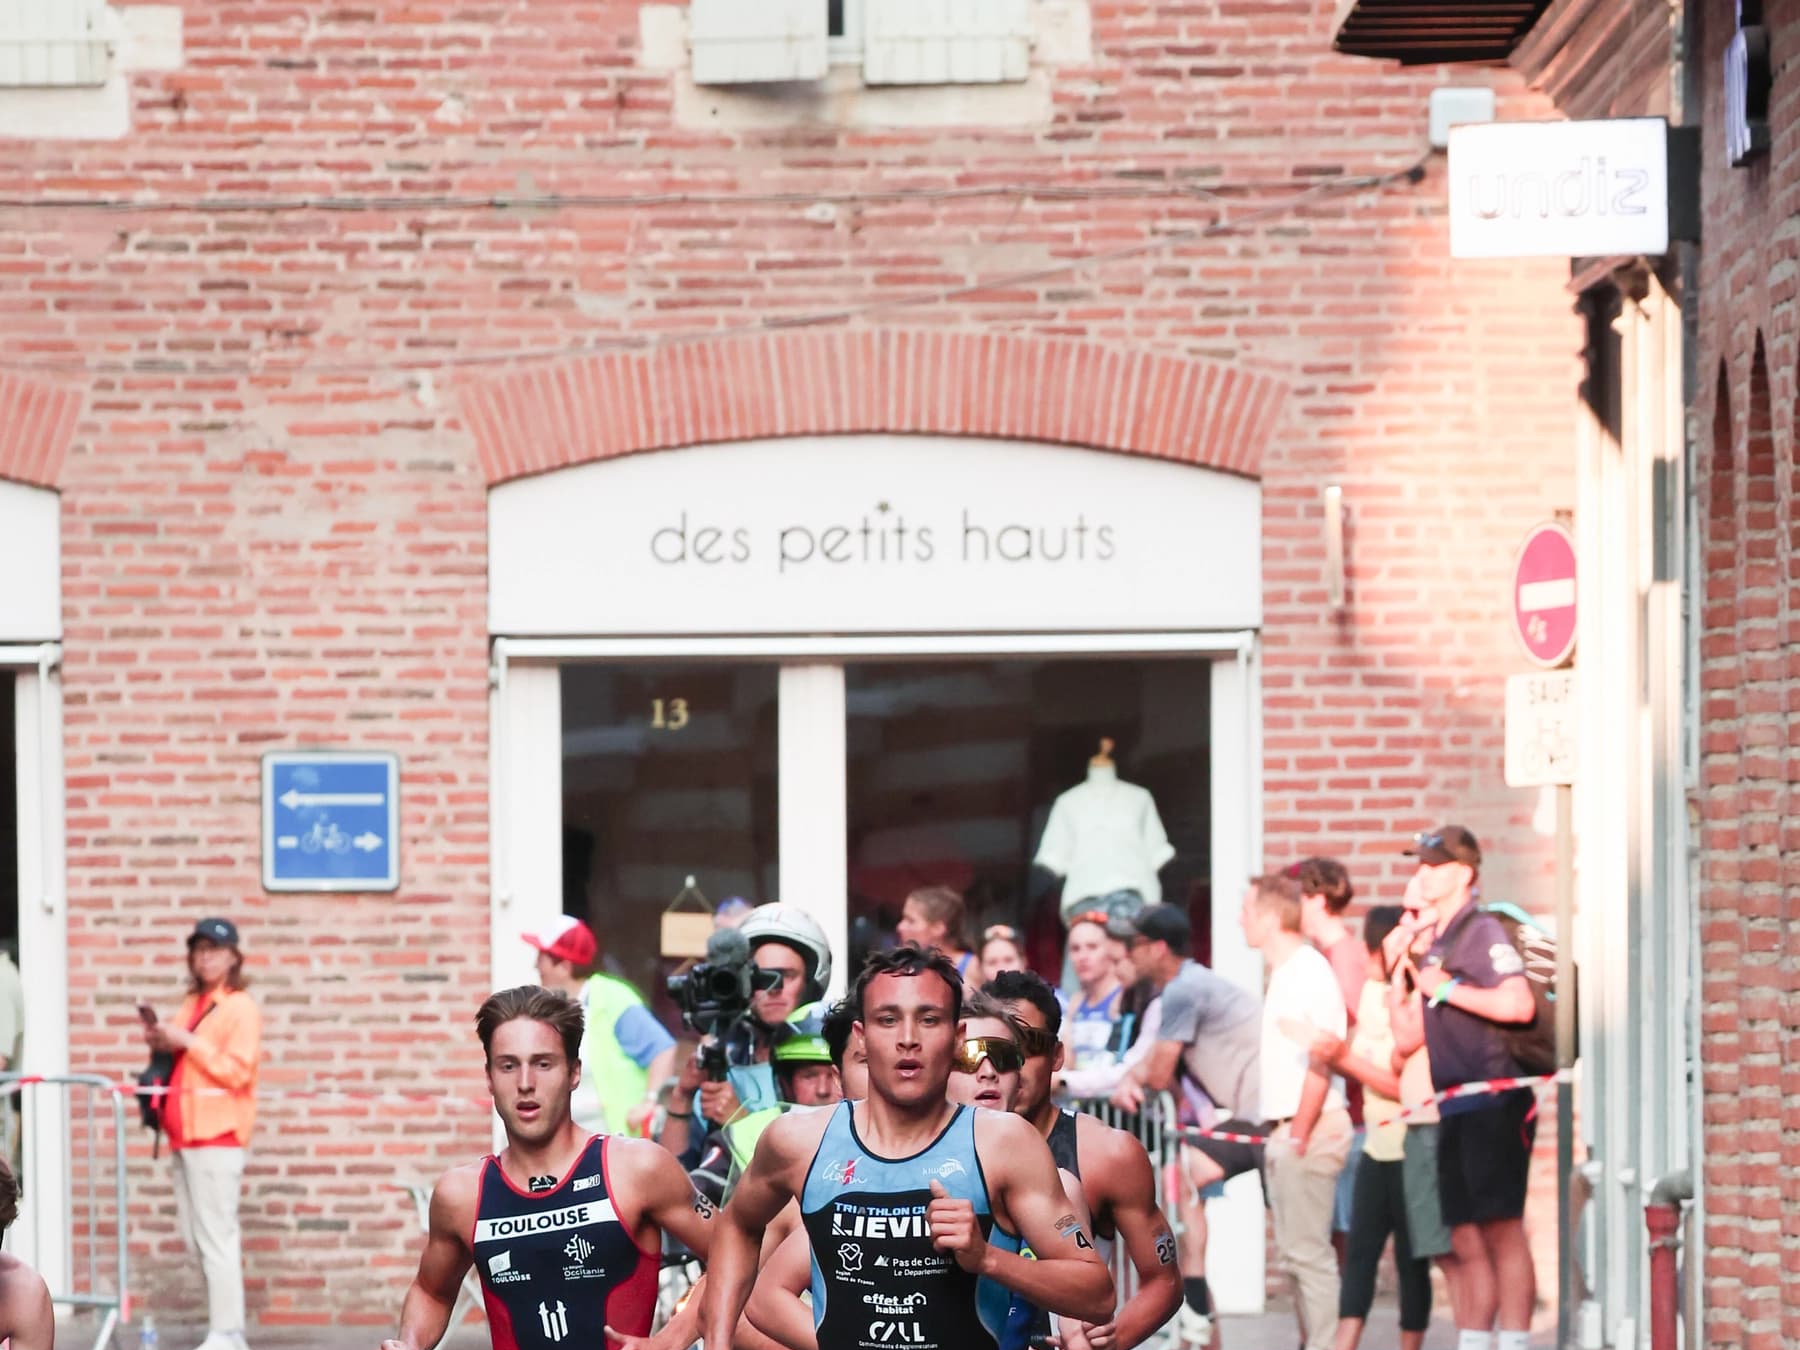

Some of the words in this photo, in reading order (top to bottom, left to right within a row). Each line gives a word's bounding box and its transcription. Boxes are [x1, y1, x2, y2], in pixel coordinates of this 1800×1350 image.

[1469, 155, 1649, 219] undiz
[650, 511, 751, 564] des
[779, 500, 935, 573] petits
[962, 509, 1116, 562] hauts
[650, 698, 689, 730] 13
[834, 1202, 910, 1216] TRIATHLON
[489, 1207, 590, 1237] TOULOUSE
[892, 1258, 909, 1267] Pas
[911, 1257, 922, 1267] de
[491, 1273, 532, 1284] TOULOUSE
[563, 1267, 606, 1277] Occitanie
[862, 1293, 899, 1306] effet
[875, 1304, 914, 1315] habitat
